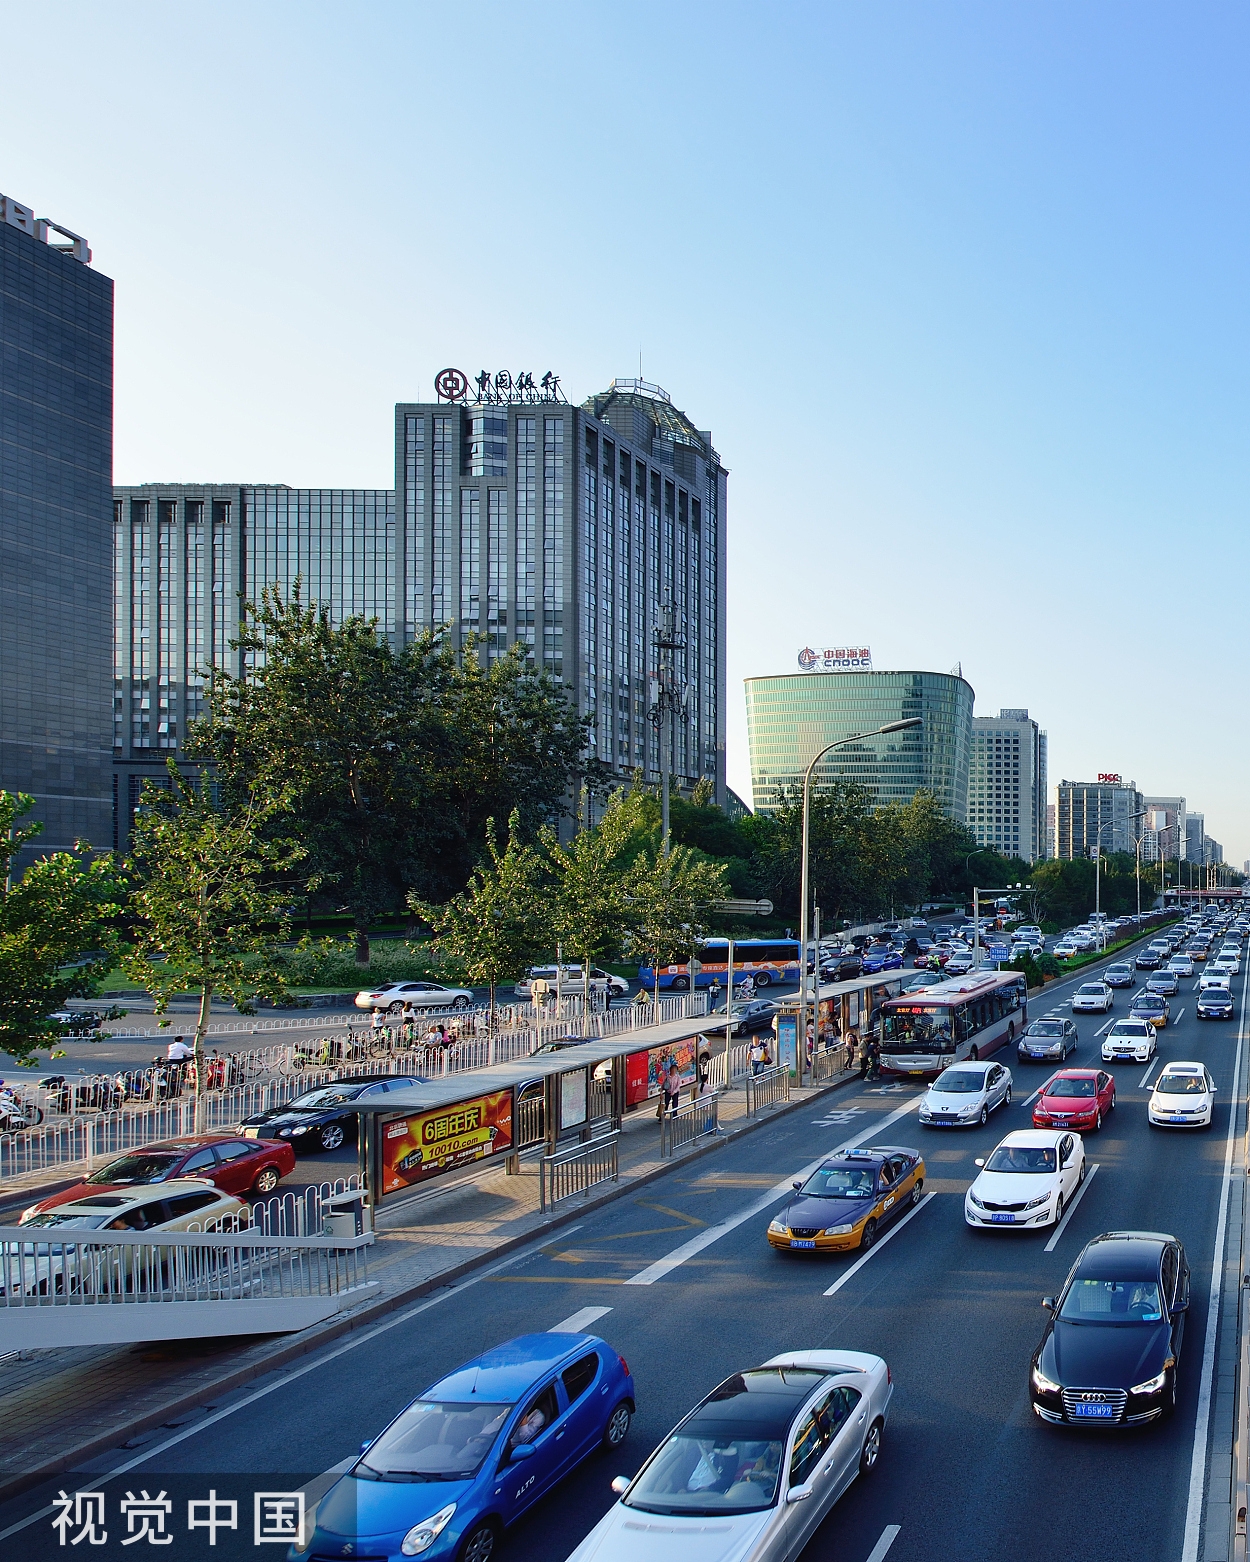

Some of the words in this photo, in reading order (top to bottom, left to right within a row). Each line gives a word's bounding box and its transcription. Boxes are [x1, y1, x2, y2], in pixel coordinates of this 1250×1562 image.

[824, 648, 869, 659] 中国海油
[1098, 773, 1119, 782] PICC
[425, 1108, 479, 1140] 6周年庆
[429, 1136, 479, 1158] 10010.com
[515, 1475, 535, 1499] ALTO
